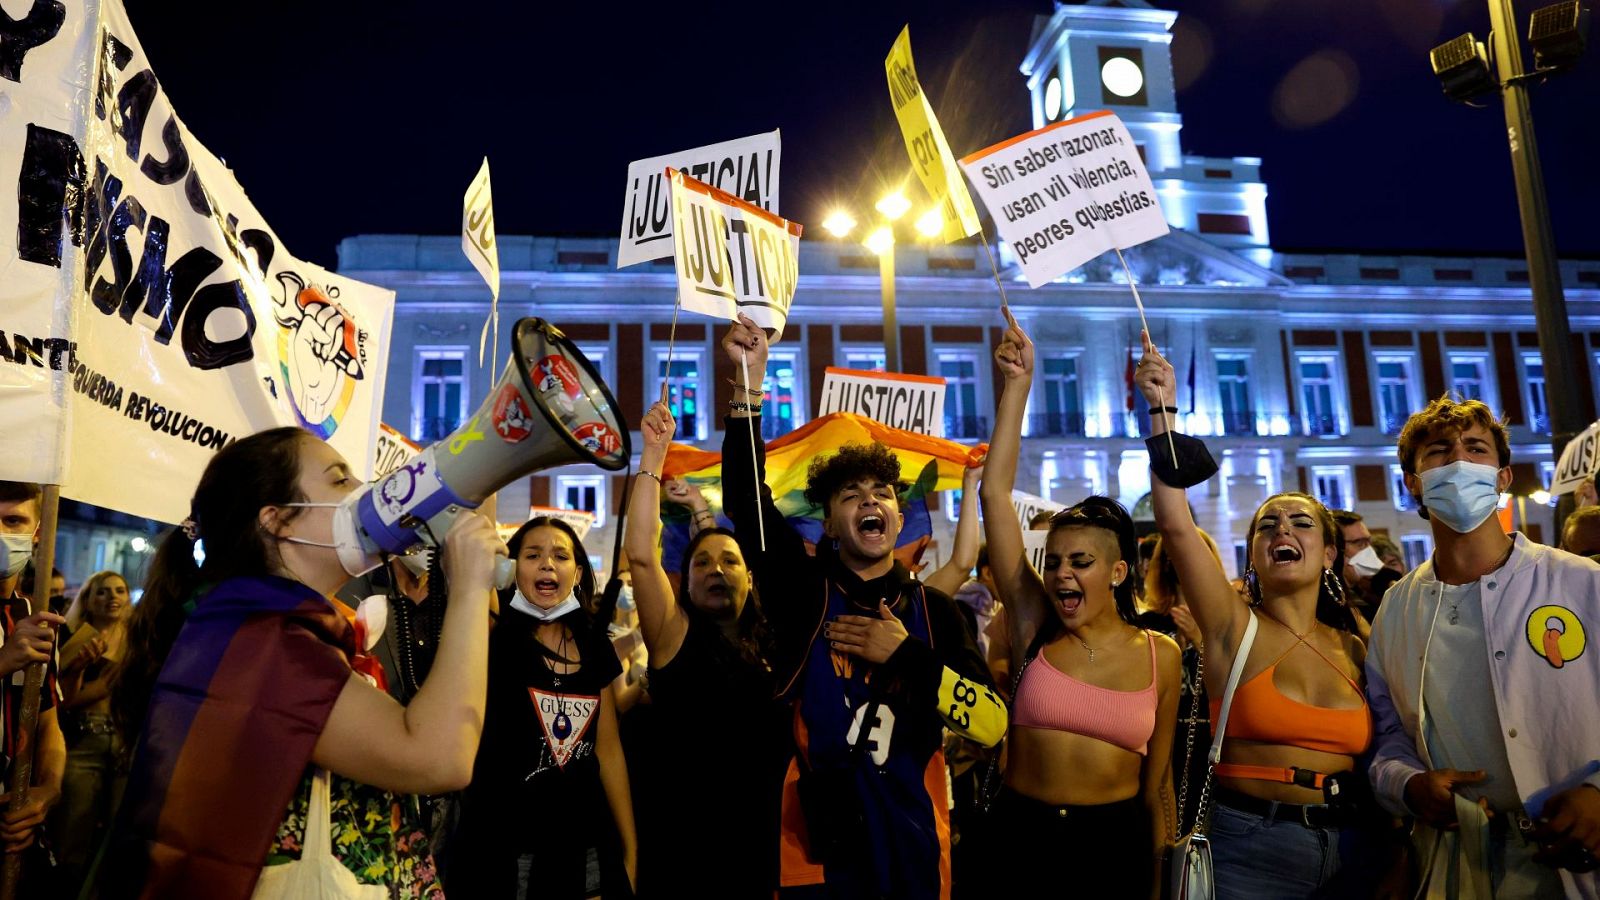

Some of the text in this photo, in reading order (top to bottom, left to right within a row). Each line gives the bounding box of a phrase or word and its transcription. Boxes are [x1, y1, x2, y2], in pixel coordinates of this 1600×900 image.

[981, 127, 1124, 190] Sin saber razonar,
[1001, 189, 1047, 223] usan
[1043, 173, 1071, 202] vil
[1013, 217, 1075, 265] peores
[124, 391, 237, 451] REVOLUCION
[540, 697, 592, 718] GUESS
